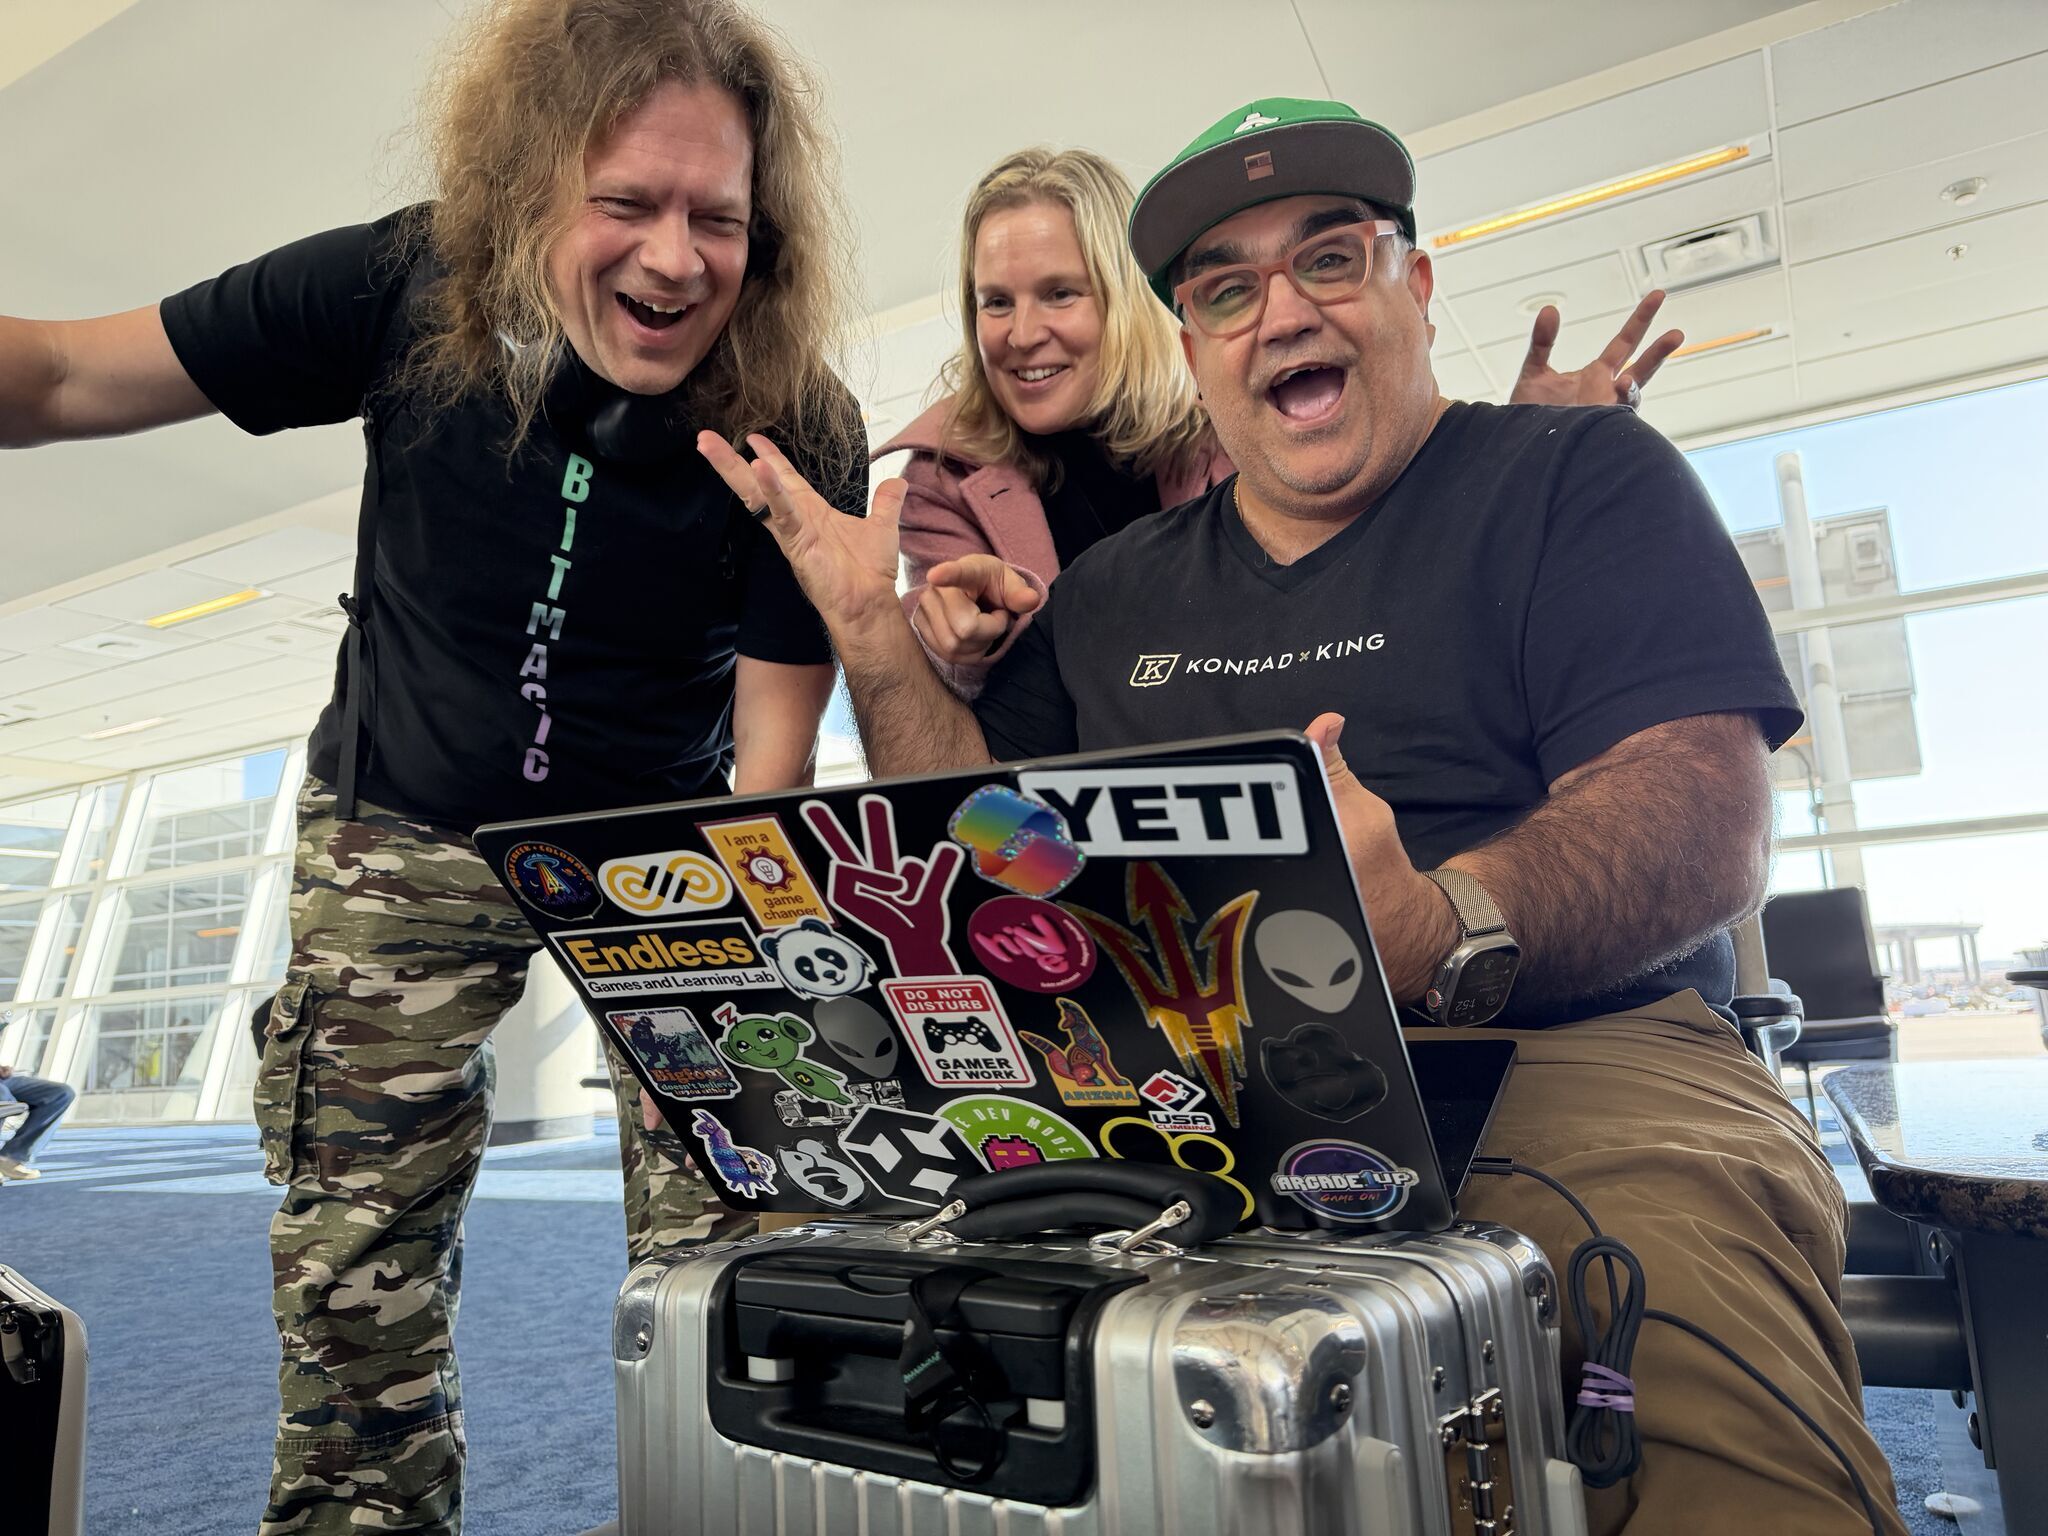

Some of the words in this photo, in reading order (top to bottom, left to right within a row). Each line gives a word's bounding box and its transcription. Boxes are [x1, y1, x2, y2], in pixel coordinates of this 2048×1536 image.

[521, 453, 594, 782] BITMAGIC
[1185, 653, 1293, 676] KONRAD
[1315, 633, 1385, 661] KING
[723, 835, 732, 847] I
[733, 834, 758, 845] am
[759, 833, 770, 843] a
[764, 895, 804, 909] game
[564, 934, 755, 974] Endless
[588, 980, 641, 993] Games
[644, 977, 673, 991] and
[671, 973, 744, 988] Learning
[743, 971, 775, 984] Lab
[903, 990, 929, 1000] DO
[937, 989, 973, 999] NOT
[906, 1000, 983, 1011] DISTURB
[935, 1058, 1013, 1070] GAMER
[942, 1071, 960, 1080] AT
[965, 1070, 1018, 1080] WORK
[1152, 1114, 1211, 1125] USA
[973, 1107, 1011, 1121] DEV
[1026, 1116, 1076, 1154] MODE
[1320, 1193, 1354, 1202] GAME
[1360, 1192, 1380, 1201] ON!
